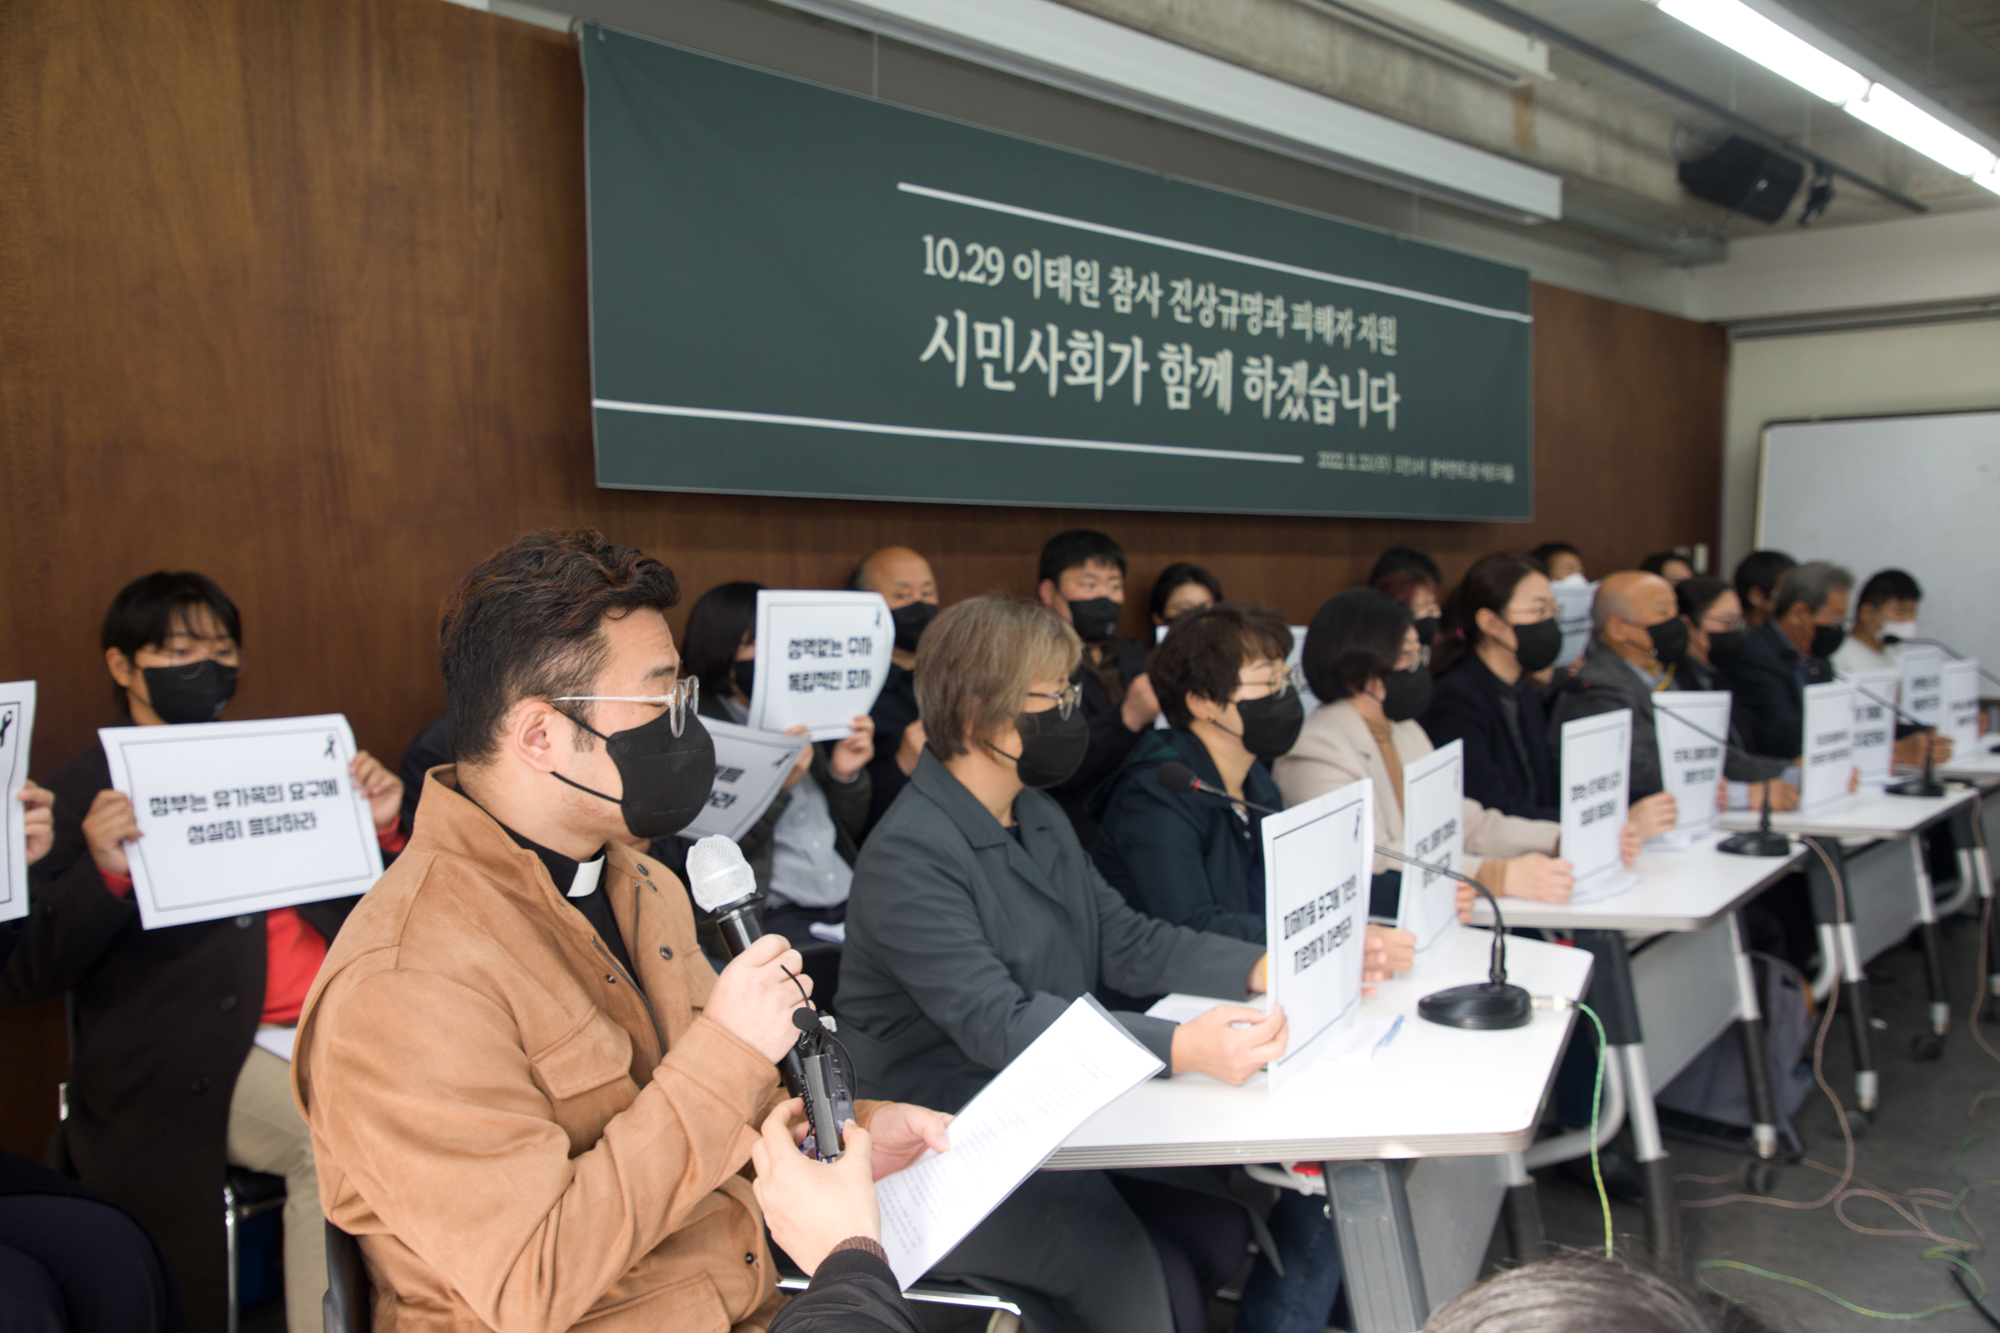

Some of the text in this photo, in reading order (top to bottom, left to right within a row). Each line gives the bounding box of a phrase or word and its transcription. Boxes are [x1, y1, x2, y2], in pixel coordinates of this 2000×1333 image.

[922, 234, 1398, 356] 10.29 이태원 참사 진상규명과 피해자 지원
[919, 308, 1402, 432] 시민사회가 함께 하겠습니다
[149, 778, 339, 817] 정부는 유가족의 요구에
[187, 820, 243, 846] 성실히
